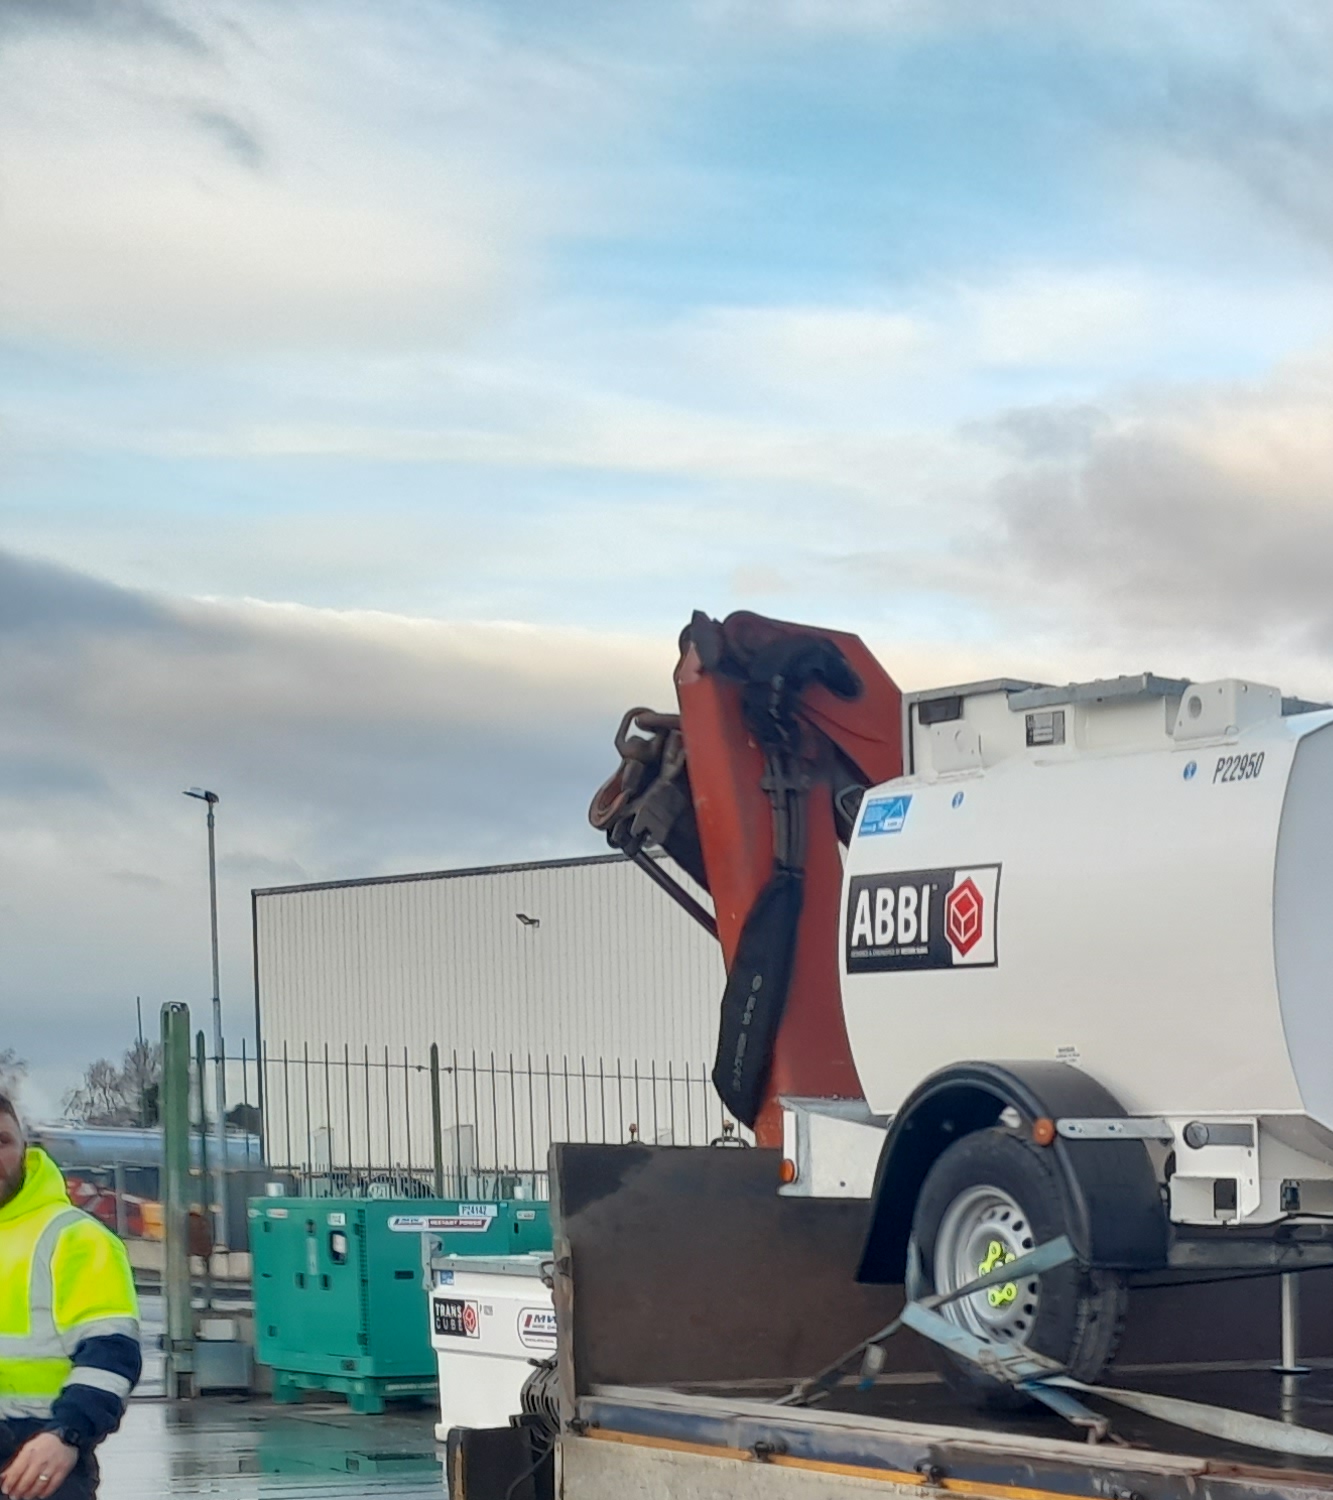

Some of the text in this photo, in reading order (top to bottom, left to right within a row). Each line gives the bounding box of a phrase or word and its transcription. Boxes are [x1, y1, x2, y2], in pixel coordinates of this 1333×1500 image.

[1212, 751, 1265, 784] P22950
[850, 883, 931, 948] ABBI
[434, 1303, 463, 1318] TRANS
[435, 1317, 464, 1332] CUBE
